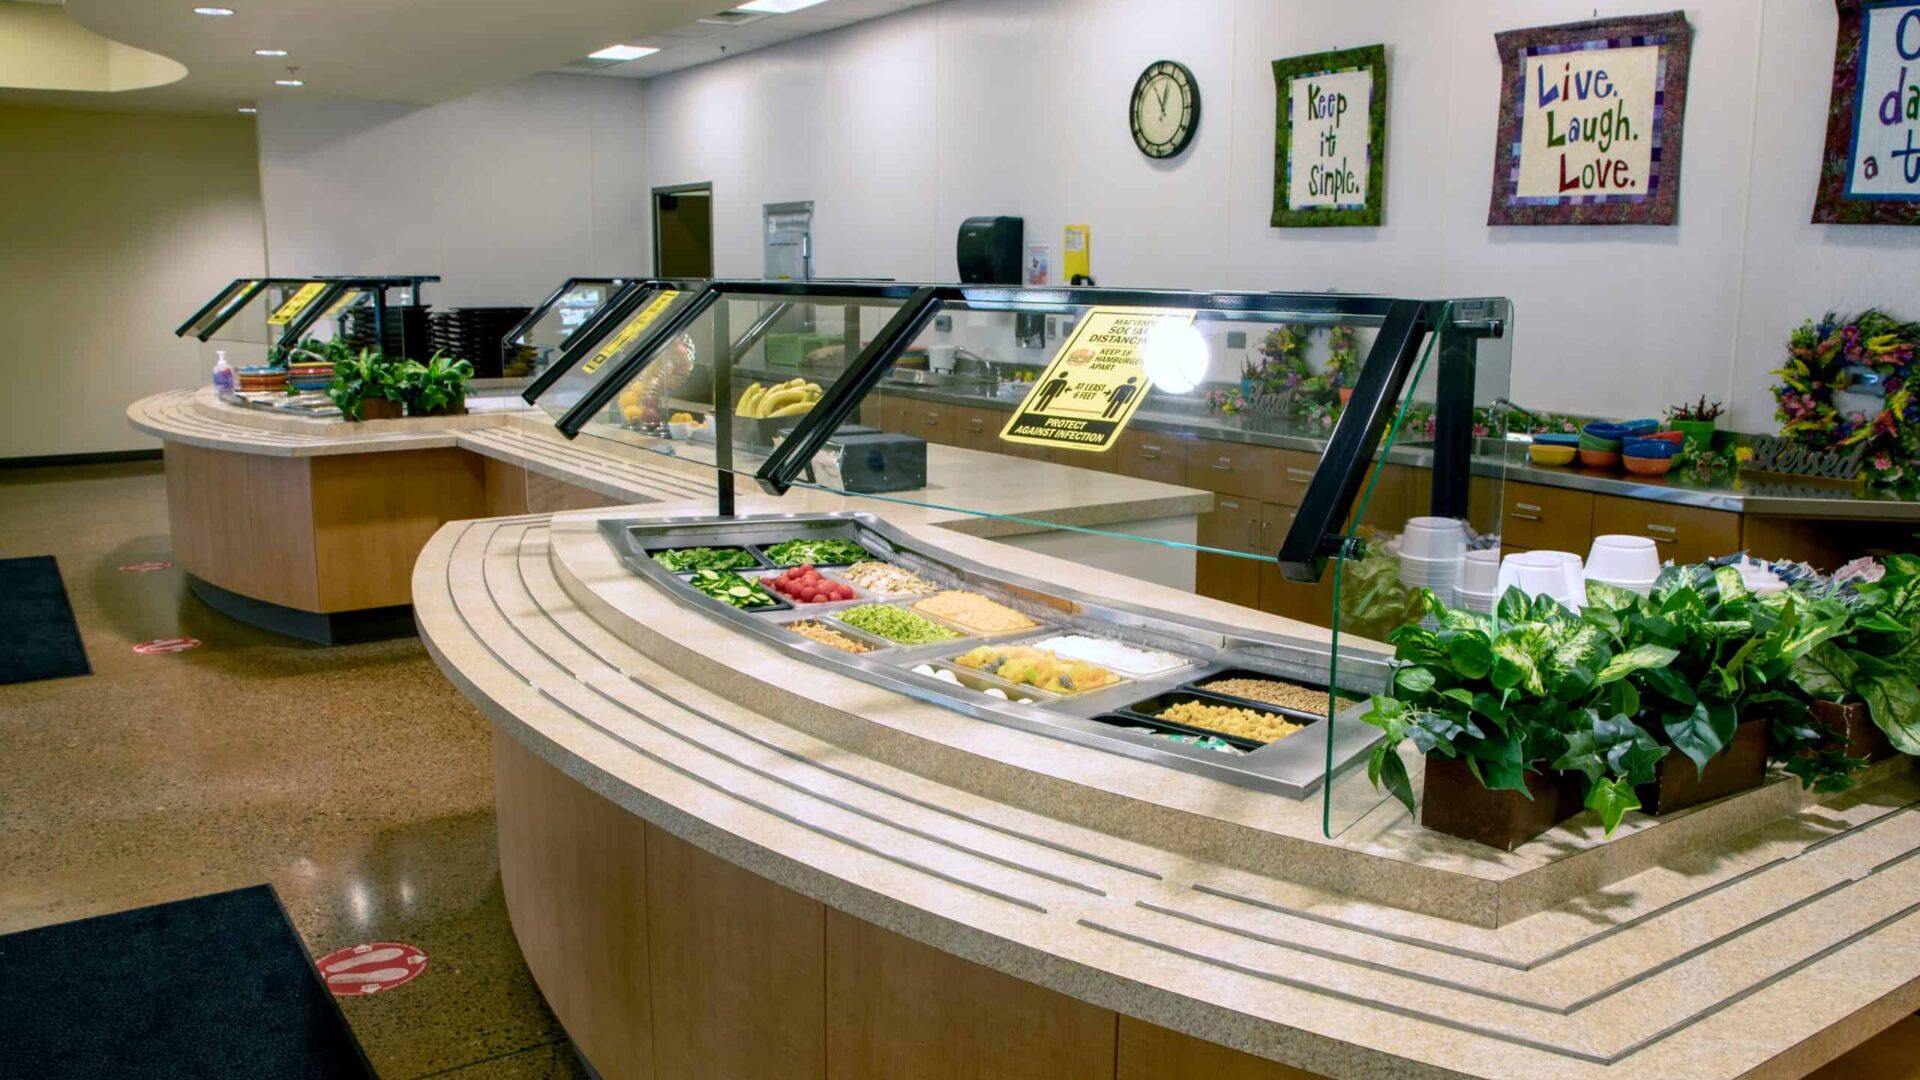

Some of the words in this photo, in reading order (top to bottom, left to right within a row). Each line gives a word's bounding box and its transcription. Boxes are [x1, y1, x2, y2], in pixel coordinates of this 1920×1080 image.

[1538, 62, 1617, 109] Live.
[1879, 66, 1920, 126] da
[1308, 83, 1347, 128] Keep
[1320, 125, 1336, 157] it
[1547, 98, 1638, 153] Laugh.
[1309, 157, 1359, 203] Simple.
[1559, 152, 1635, 193] Love.
[1863, 155, 1878, 180] a
[1088, 363, 1116, 371] APART
[1074, 382, 1087, 390] AT
[1085, 383, 1107, 392] LEAST
[1079, 392, 1096, 400] FEET
[1014, 425, 1056, 438] AGAINST
[1054, 429, 1105, 443] INFECTION
[1044, 418, 1088, 430] PROTECT
[1745, 434, 1867, 480] Blessed
